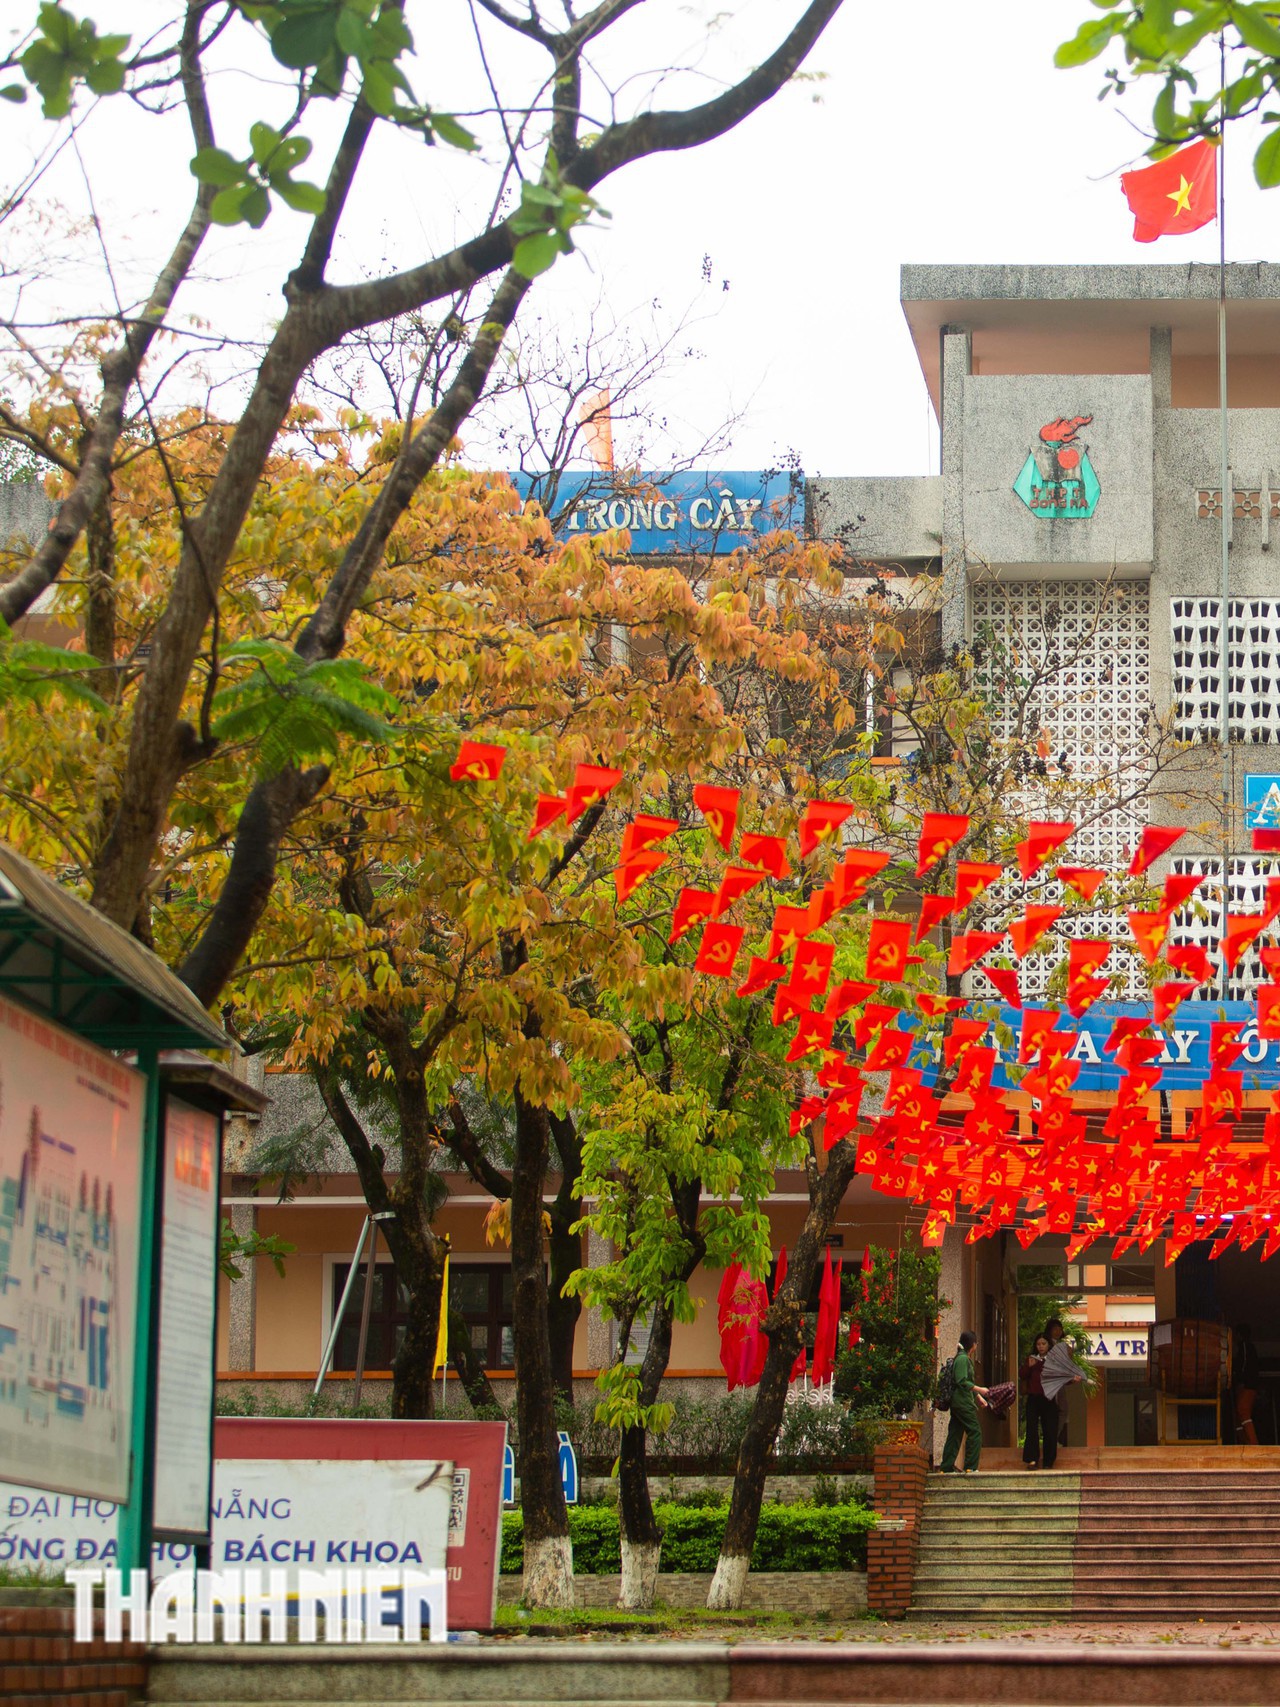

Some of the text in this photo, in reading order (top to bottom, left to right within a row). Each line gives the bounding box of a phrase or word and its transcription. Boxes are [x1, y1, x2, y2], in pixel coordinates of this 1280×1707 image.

[1033, 487, 1081, 499] THPT
[689, 488, 762, 531] CÂY
[9, 1496, 60, 1524] ĐẠI
[71, 1496, 118, 1524] HỌ
[75, 1538, 118, 1568] ĐẠ
[223, 1533, 316, 1563] BÁCH
[326, 1540, 423, 1564] KHOA
